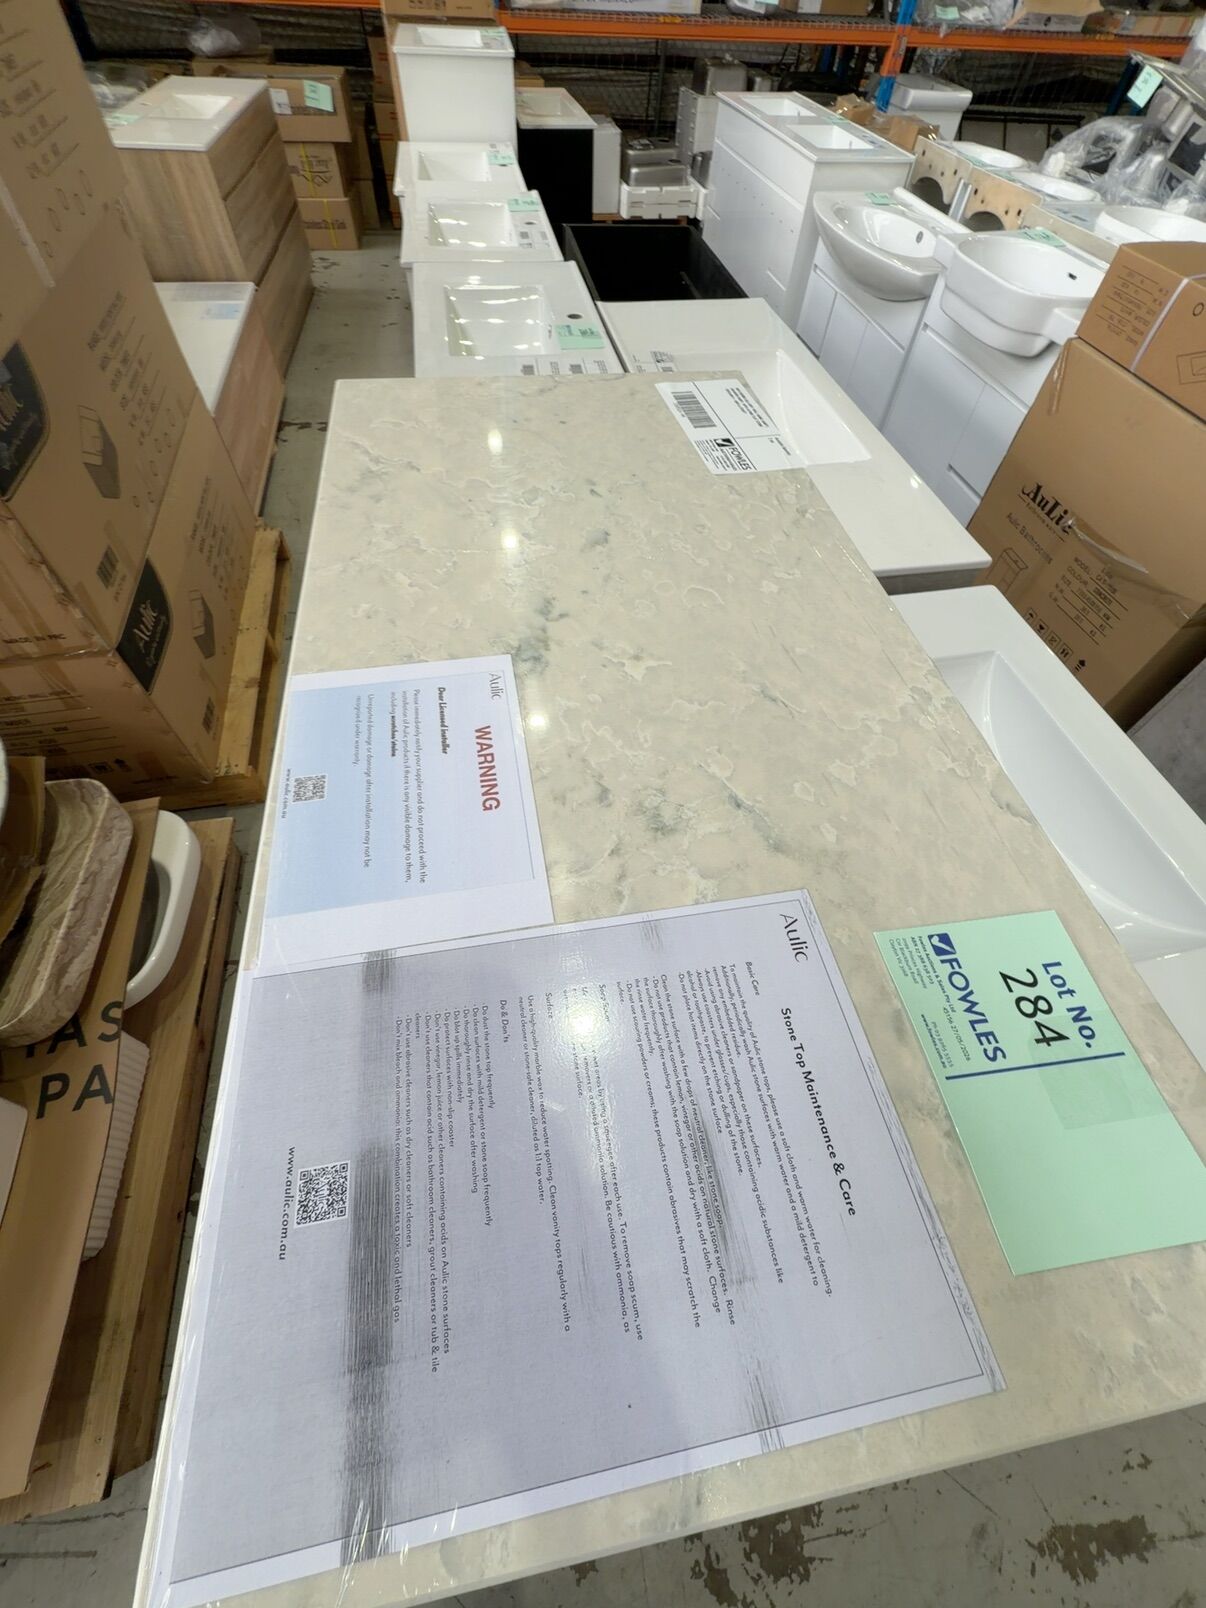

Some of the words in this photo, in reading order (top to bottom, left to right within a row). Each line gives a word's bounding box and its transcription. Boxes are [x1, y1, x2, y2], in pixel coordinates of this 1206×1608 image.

[437, 686, 446, 701] Dear
[487, 672, 504, 700] Aulic
[438, 701, 448, 728] Licensed
[473, 724, 501, 812] WARNING
[779, 911, 809, 963] Aulic
[731, 972, 744, 998] maintain
[939, 957, 1007, 1063] FOWLES
[998, 966, 1072, 1048] 284
[1041, 960, 1078, 999] Lot
[1065, 1005, 1096, 1049] No.
[26, 1001, 124, 1058] AS
[501, 1018, 510, 1043] Don'ts
[740, 1009, 754, 1031] quality
[780, 1007, 797, 1041] Stone
[751, 1038, 761, 1055] Aulic
[792, 1042, 806, 1068] Top
[756, 1056, 766, 1075] stone
[36, 1064, 113, 1120] PA
[762, 1075, 771, 1093] tops,
[765, 1093, 779, 1116] please
[801, 1069, 837, 1159] Maintenance
[774, 1117, 783, 1130] use
[780, 1137, 791, 1152] soft
[476, 1094, 486, 1131] detergent
[481, 1183, 493, 1227] frequently
[609, 1160, 618, 1180] after
[785, 1152, 798, 1173] cloth
[831, 1161, 846, 1175] &
[612, 1181, 622, 1202] each
[791, 1173, 803, 1190] and
[278, 1146, 295, 1261] www.aulic.com.au
[796, 1190, 808, 1215] warm
[837, 1177, 856, 1217] Care
[427, 1205, 436, 1245] cleaners,
[618, 1221, 627, 1234] To
[804, 1215, 816, 1240] water
[426, 1245, 437, 1271] grout
[620, 1234, 631, 1269] remove
[811, 1240, 820, 1254] for
[626, 1269, 635, 1293] soap
[816, 1255, 832, 1297] cleaning.
[630, 1293, 639, 1323] scum,
[430, 1325, 439, 1344] tub
[634, 1322, 643, 1341] use
[431, 1355, 440, 1373] tile
